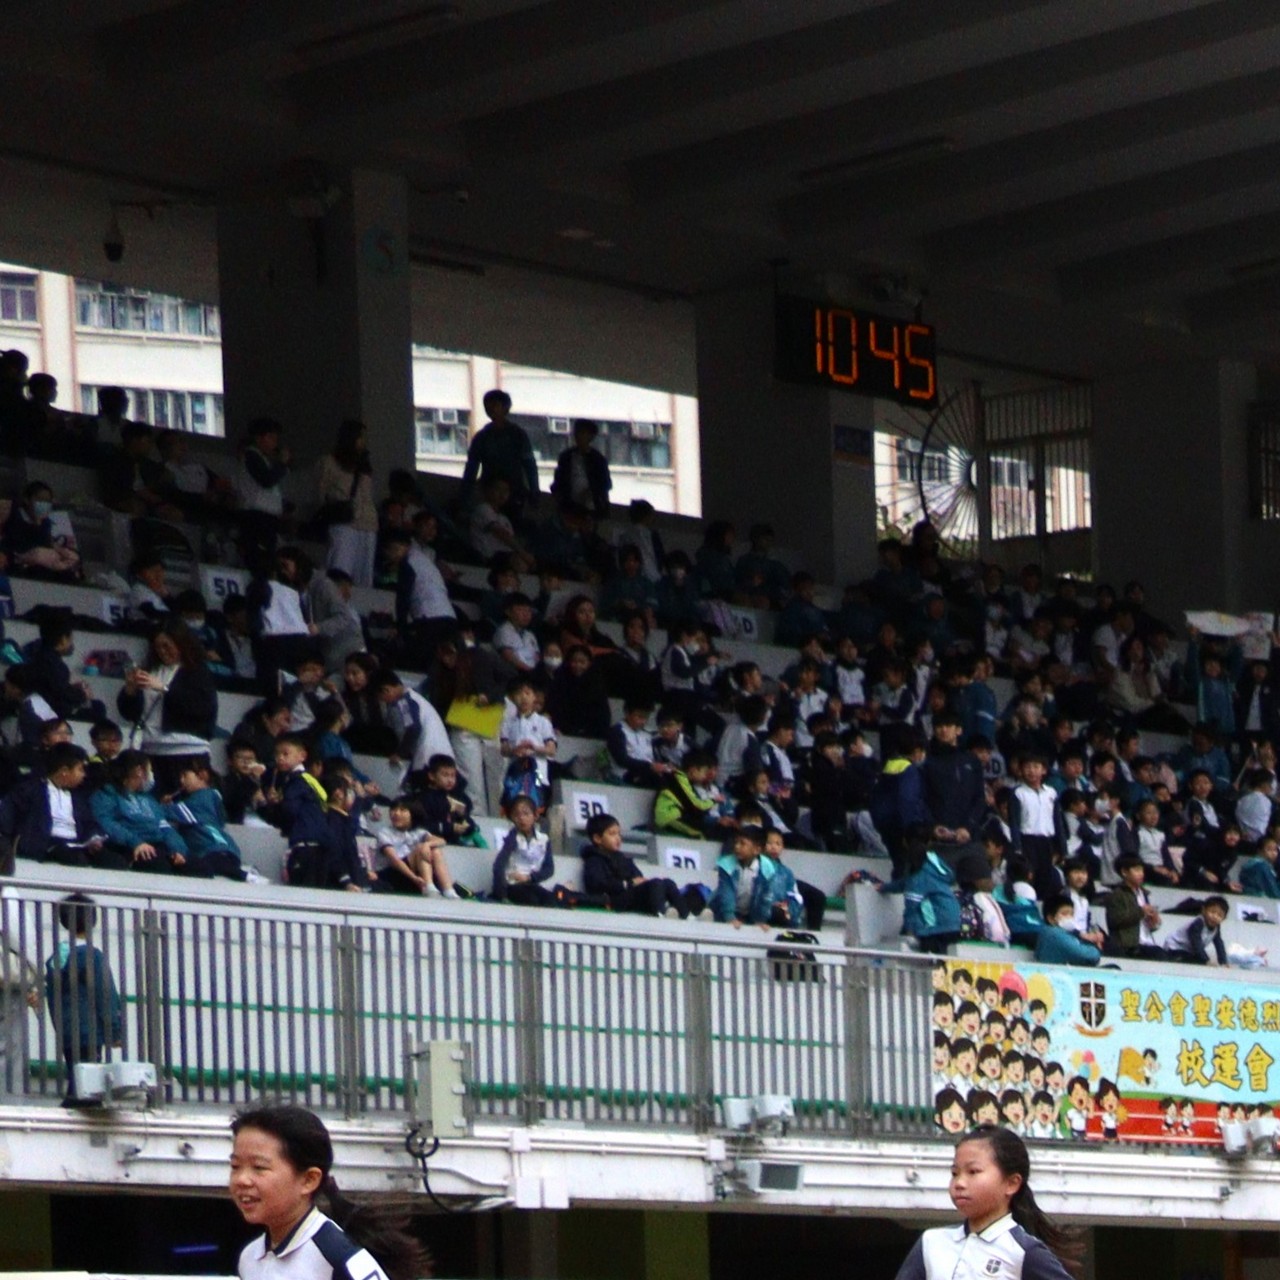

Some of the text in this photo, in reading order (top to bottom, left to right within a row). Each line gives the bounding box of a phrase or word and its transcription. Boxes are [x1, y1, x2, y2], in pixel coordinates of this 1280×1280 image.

[212, 576, 239, 597] 5D
[579, 799, 604, 819] 3D
[1176, 1037, 1275, 1093] 校運會
